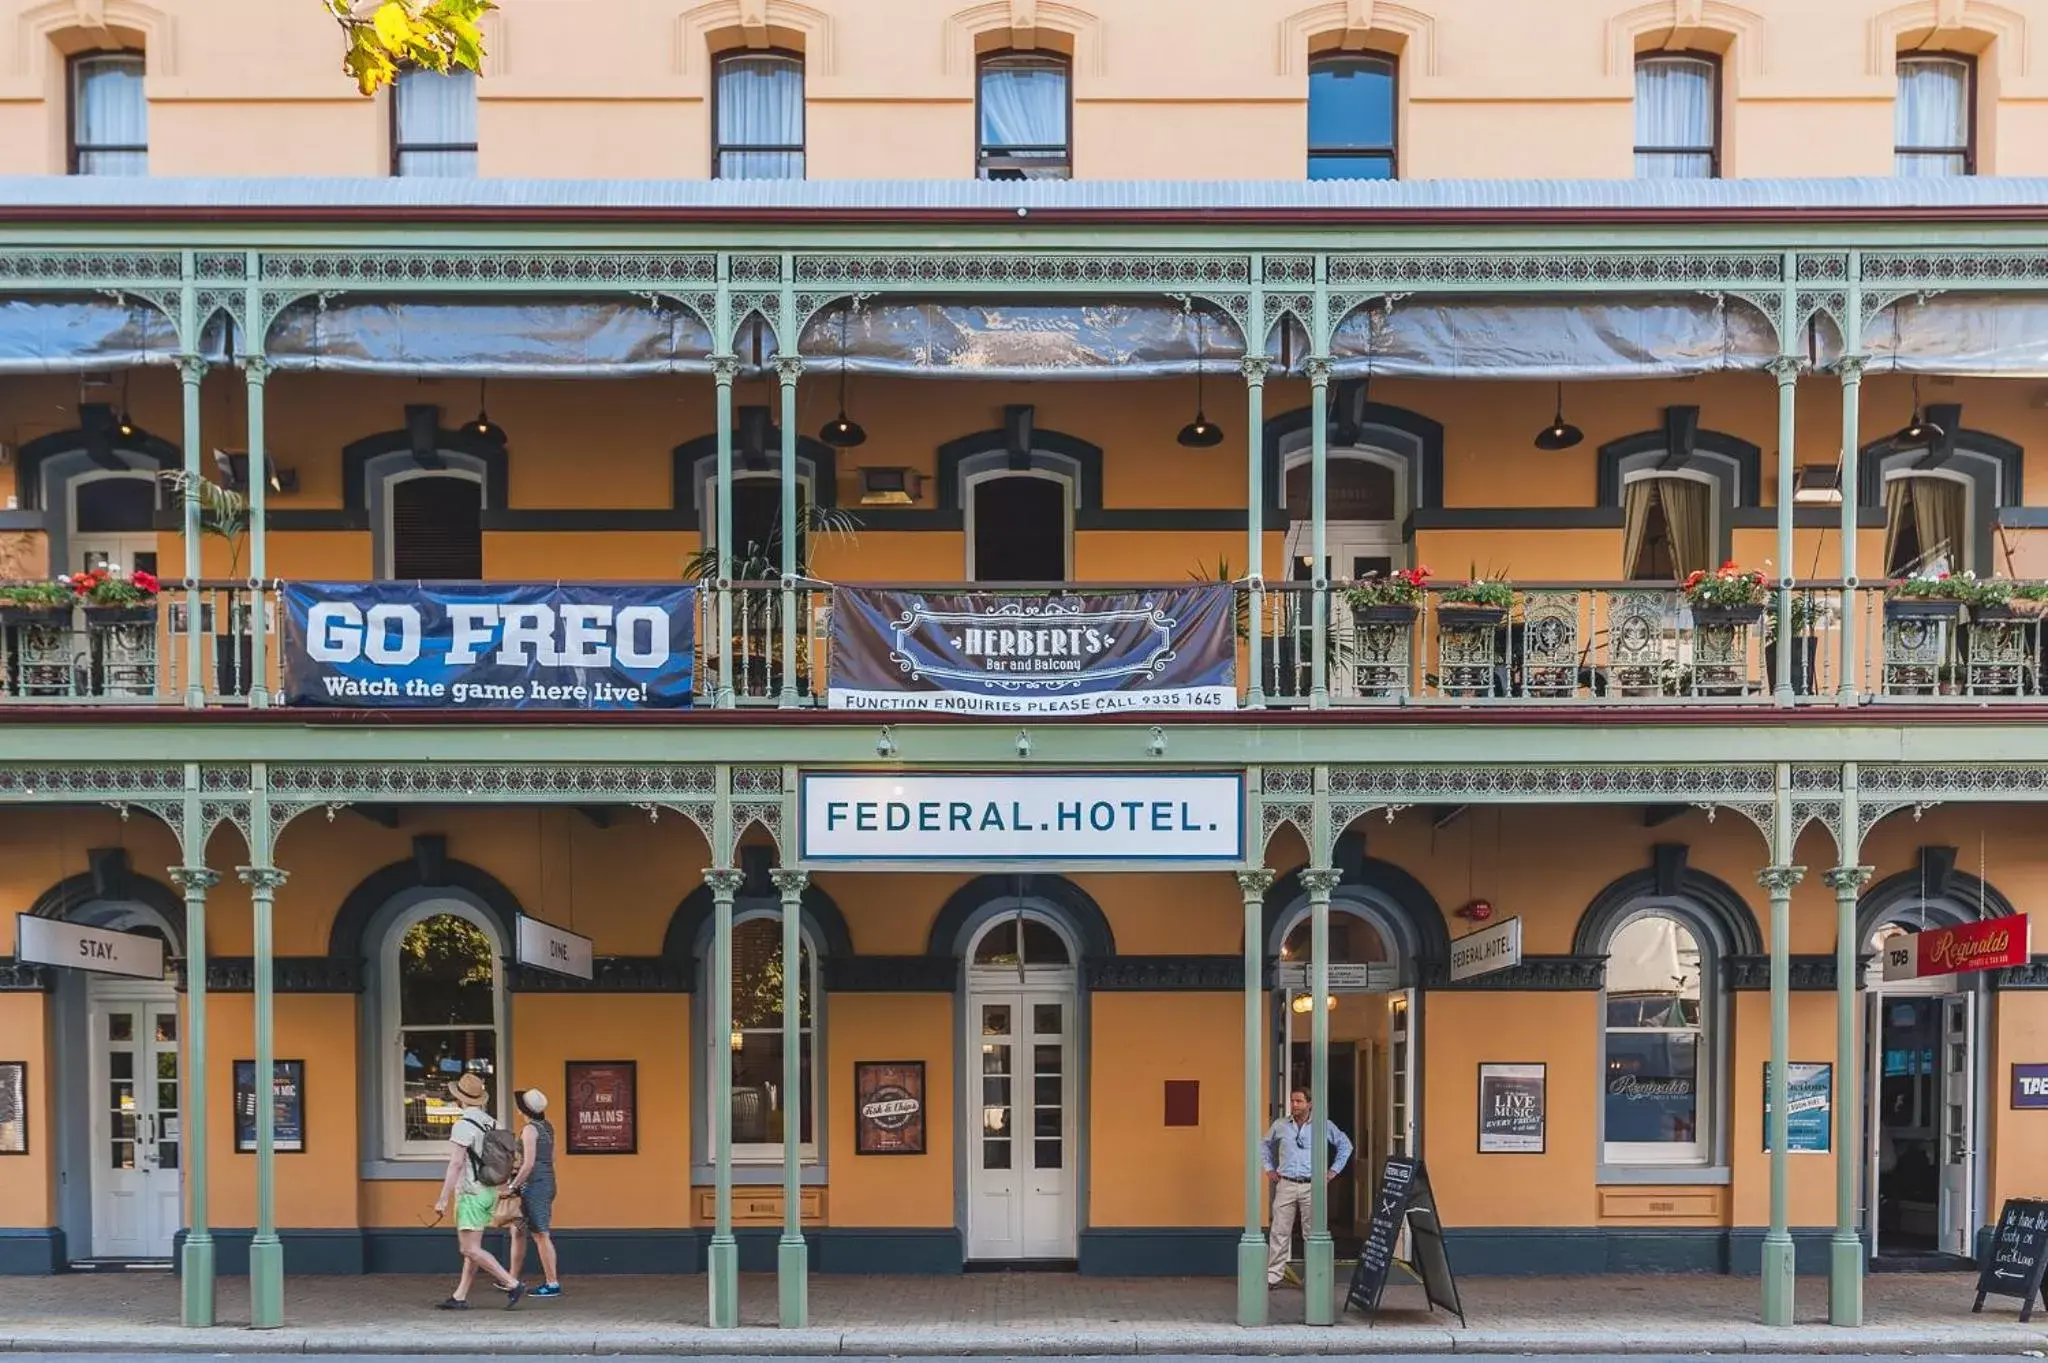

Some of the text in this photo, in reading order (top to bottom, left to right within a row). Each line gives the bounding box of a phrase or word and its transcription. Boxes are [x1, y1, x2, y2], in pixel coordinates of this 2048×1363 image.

[306, 601, 670, 669] GO FREO
[964, 626, 1101, 656] HERBERT'S
[986, 658, 1081, 673] Bar and Balcony
[322, 676, 648, 703] Watch the game here live!
[845, 692, 1222, 712] FUNCTION ENQUIRIES PLEASE CALL 9335 1645
[79, 939, 118, 961] STAY.
[1889, 948, 1908, 966] TAB
[2019, 1076, 2048, 1095] TAB
[1495, 1094, 1536, 1108] LIVE
[579, 1109, 624, 1124] MAINS
[1486, 1118, 1511, 1128] EVERY
[1513, 1115, 1541, 1126] FRIDAY
[1494, 1107, 1534, 1118] MUSIC
